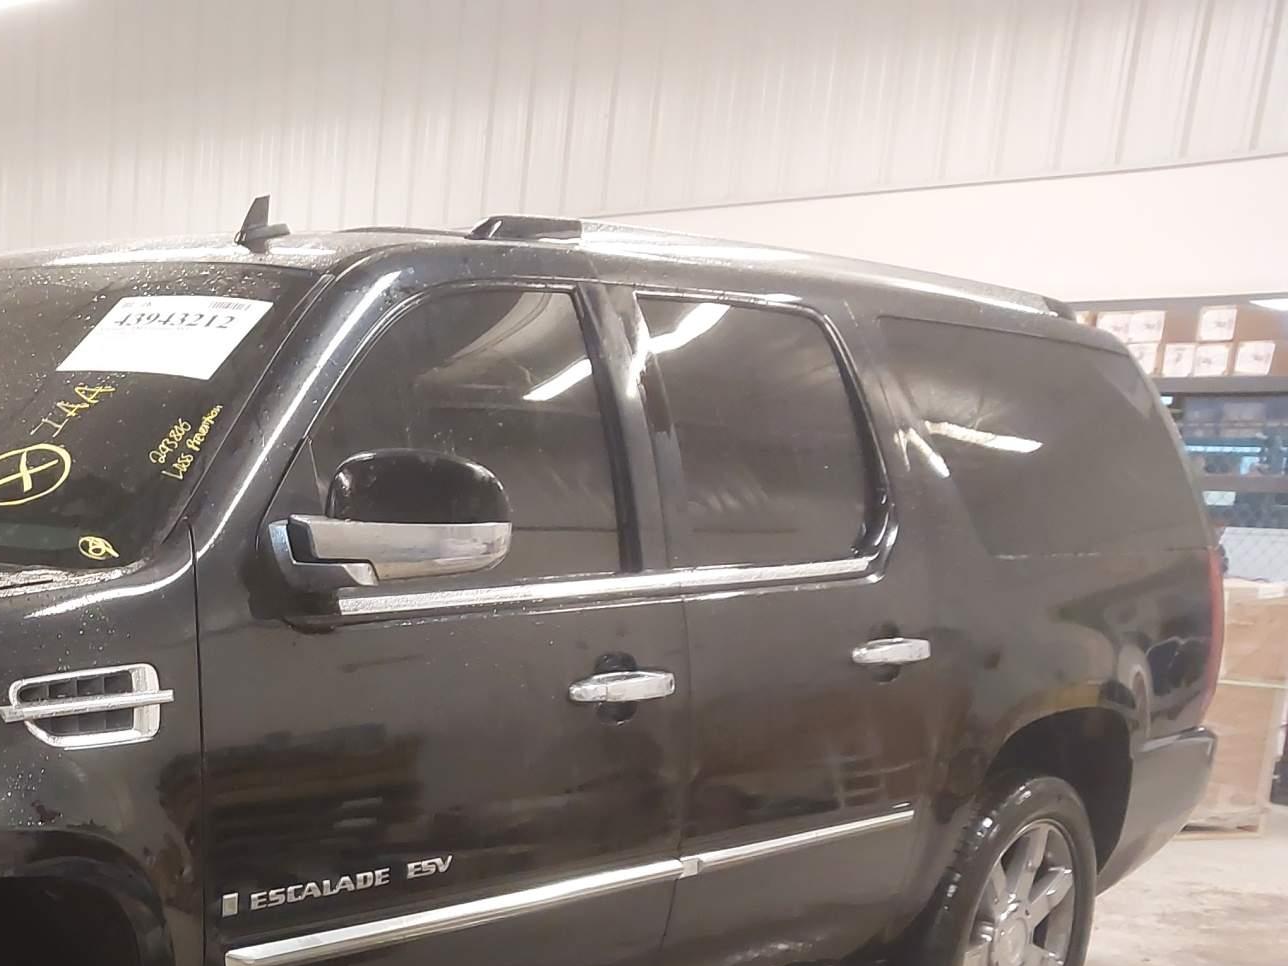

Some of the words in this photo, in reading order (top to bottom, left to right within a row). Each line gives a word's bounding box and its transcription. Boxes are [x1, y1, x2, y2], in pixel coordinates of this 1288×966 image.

[114, 312, 235, 329] 43943212
[30, 386, 116, 438] IAA
[250, 868, 390, 911] ESCALADE
[406, 855, 453, 880] ESV
